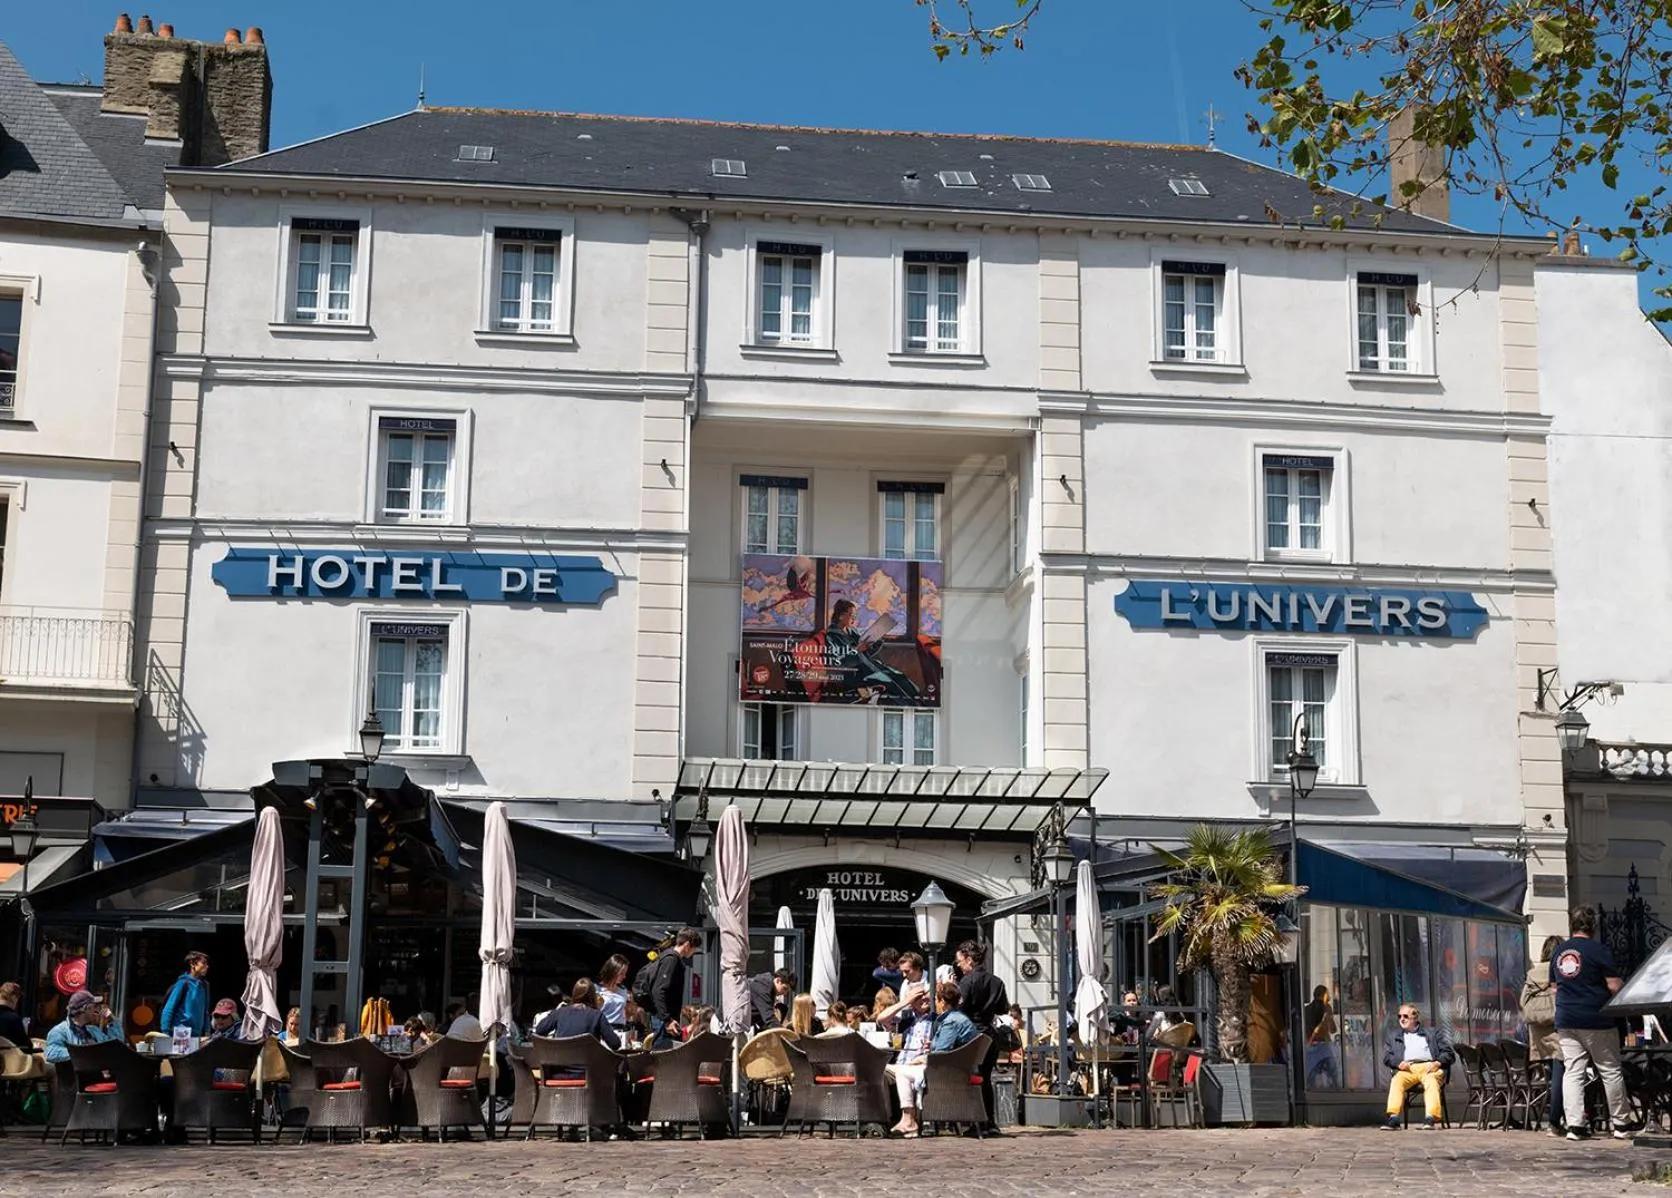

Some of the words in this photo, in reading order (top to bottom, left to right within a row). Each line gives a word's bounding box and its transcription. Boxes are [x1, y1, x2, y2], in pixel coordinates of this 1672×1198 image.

[400, 419, 434, 430] HOTEL
[1281, 457, 1313, 467] HOTEL
[266, 554, 463, 592] HOTEL
[500, 567, 559, 595] DE
[1160, 588, 1448, 629] L'UNIVERS
[769, 649, 843, 669] Voyageurs
[826, 872, 885, 886] HOTEL
